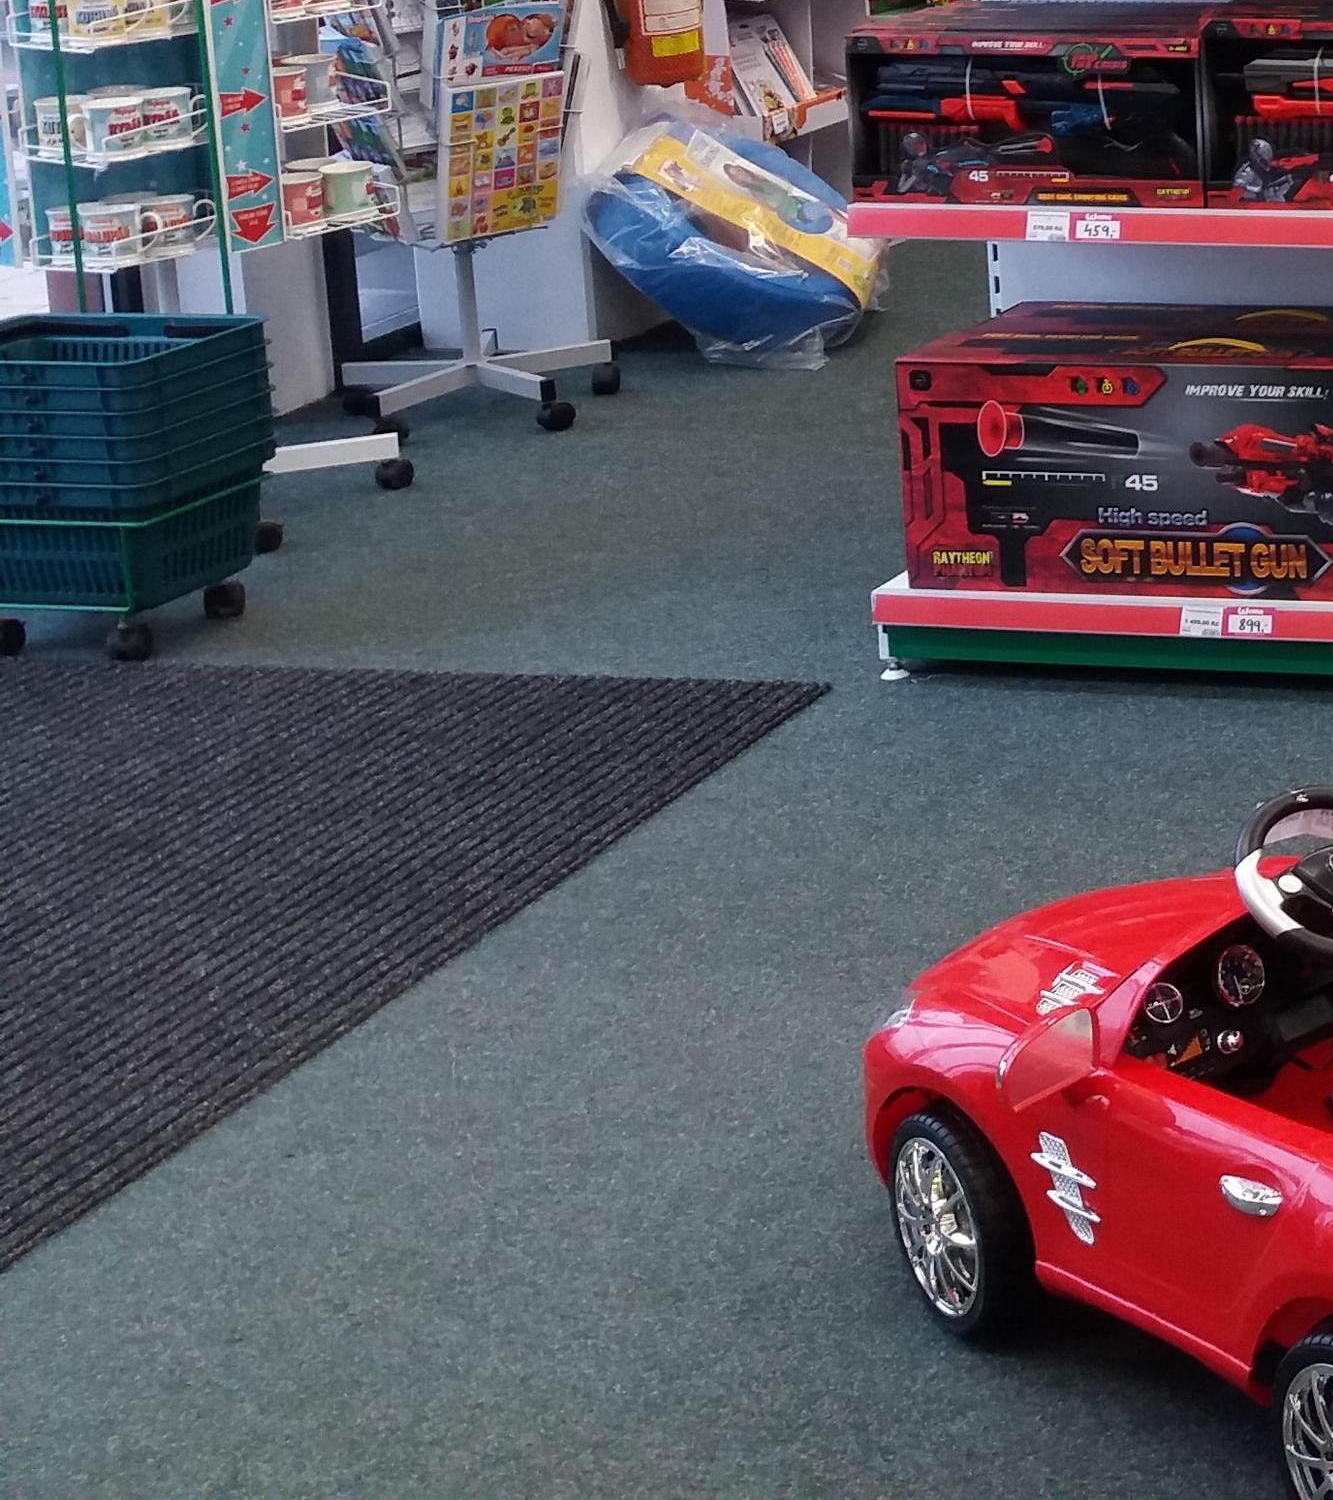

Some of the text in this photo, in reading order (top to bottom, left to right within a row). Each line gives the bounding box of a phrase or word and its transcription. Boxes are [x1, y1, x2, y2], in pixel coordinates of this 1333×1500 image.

[968, 170, 989, 182] 45
[1185, 384, 1245, 397] IMPROVE
[1249, 385, 1285, 398] YOUR
[1124, 474, 1159, 491] 45
[1098, 507, 1208, 527] High speed
[932, 551, 991, 566] RAYTHEON
[1080, 538, 1307, 579] SOFT BULLET GUN
